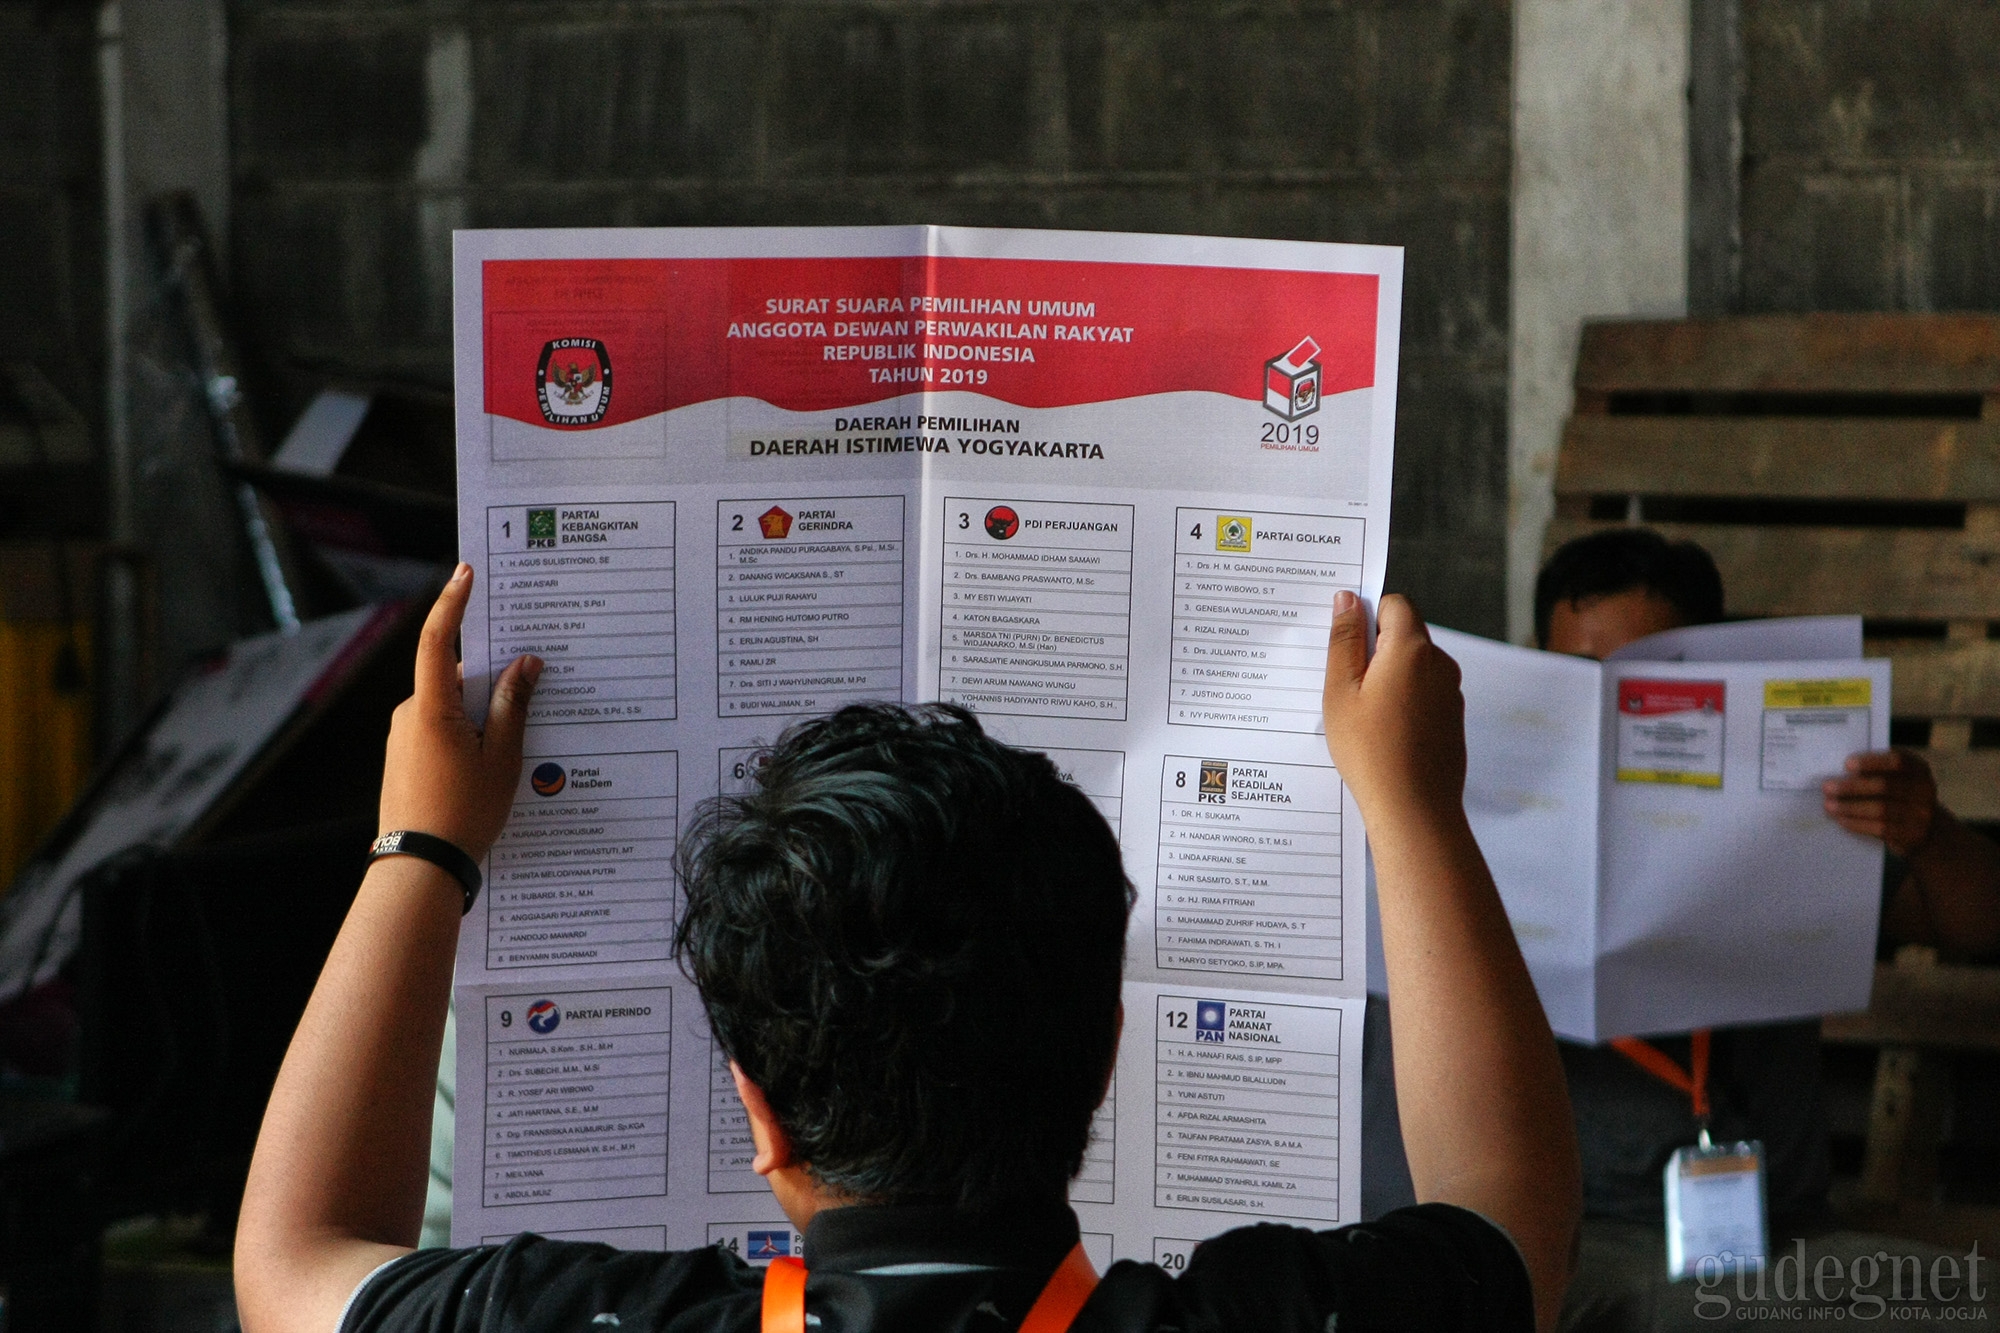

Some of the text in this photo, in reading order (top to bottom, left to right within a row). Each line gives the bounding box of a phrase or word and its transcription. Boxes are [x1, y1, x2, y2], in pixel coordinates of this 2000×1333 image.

[766, 297, 1095, 317] SURAT SUARA PEMILIHAN UMUM
[727, 320, 1134, 343] ANGGOTA DEWAN PERWAKILAN RAKYAT
[552, 339, 596, 349] KOMISI
[823, 344, 1035, 363] REPUBLIK INDONESIA
[869, 368, 988, 385] TAHUN 2019
[538, 386, 610, 424] PEMILIHAN UMUM
[835, 415, 1019, 433] DAERAH PEMILIHAN
[1261, 422, 1319, 445] 2019
[750, 436, 1104, 459] DAERAH ISTIMEWA YOGYAKARTA
[1261, 443, 1297, 451] PEMILIHAN
[562, 510, 599, 519] PARTAI
[799, 511, 835, 519] PARTAI
[562, 521, 638, 531] KEBANGKITAN
[732, 515, 743, 531] 2
[799, 521, 853, 531] GERINDRA
[959, 513, 969, 529] 3
[1025, 519, 1118, 532] PDI PERJUANGAN
[502, 521, 511, 538] 1
[1190, 523, 1202, 539] 4
[562, 534, 607, 543] BANGSA
[1256, 531, 1341, 544] PARTAI GOLKAR
[528, 539, 556, 548] PKB
[740, 547, 768, 555] ANDIKA
[770, 546, 797, 554] PANDU
[543, 557, 597, 566] SULISTIYONO,
[599, 556, 609, 564] SE
[965, 551, 979, 559] Drs.
[992, 552, 1039, 562] MOHAMMAD
[1069, 555, 1100, 564] SAMAWI
[1234, 564, 1274, 574] GANDUNG
[1276, 567, 1318, 577] PARDIMAN,
[965, 572, 979, 580] Drs.
[982, 573, 1020, 582] BAMBANG
[1022, 575, 1074, 584] PRASWANTO,
[1196, 583, 1223, 592] YANTO
[1225, 585, 1261, 594] WIBOWO,
[785, 593, 817, 601] RAHAYU
[997, 595, 1032, 603] WIJAYATI
[510, 601, 532, 610] YULIS
[534, 601, 582, 610] SUPRIYATIN,
[1196, 605, 1230, 613] GENESIA
[1232, 606, 1280, 617] WULANDARI,
[786, 614, 820, 622] HUTOMO
[821, 613, 849, 621] PUTRO
[992, 616, 1040, 625] BAGASKARA
[1195, 626, 1249, 636] RIZAL RINALDI
[1210, 648, 1249, 658] JULIANTO,
[1193, 668, 1268, 680] ITA SAHERNI GUMAY
[1192, 690, 1251, 700] JUSTINO DJOGO
[962, 694, 1098, 708] YOHANNIS HADIYANTO RIWU KAHO,
[1204, 712, 1236, 721] PURWITA
[1238, 714, 1269, 723] HESTUTI
[571, 768, 600, 777] Partai
[734, 763, 745, 778] 6
[1233, 768, 1268, 777] PARTAI
[571, 779, 612, 788] NasDem
[1176, 771, 1186, 788] 8
[1232, 780, 1283, 791] KEADILAN
[1199, 794, 1226, 804] PKS
[1231, 792, 1291, 803] SEJAHTERA
[1205, 812, 1240, 821] SUKAMTA
[1202, 855, 1234, 863] AFRIANI,
[1197, 876, 1233, 885] SASMITO,
[1223, 898, 1255, 906] FITRIANI
[566, 1006, 651, 1020] PARTAI PERINDO
[1229, 1008, 1266, 1019] PARTAI
[501, 1010, 512, 1028] 9
[1166, 1012, 1188, 1029] 12
[1229, 1020, 1272, 1031] AMANAT
[1196, 1030, 1224, 1042] PAN
[1229, 1032, 1281, 1044] NASIONAL
[1207, 1073, 1240, 1081] MAHMUD
[1242, 1076, 1286, 1085] BILALLUDIN
[1178, 1091, 1225, 1101] YUNI ASTUTI
[1178, 1112, 1267, 1125] AFDA RIZAL ARMASHITA
[1178, 1132, 1272, 1146] TAUFAN PRATAMA ZASYA,
[1162, 1253, 1185, 1270] 20
